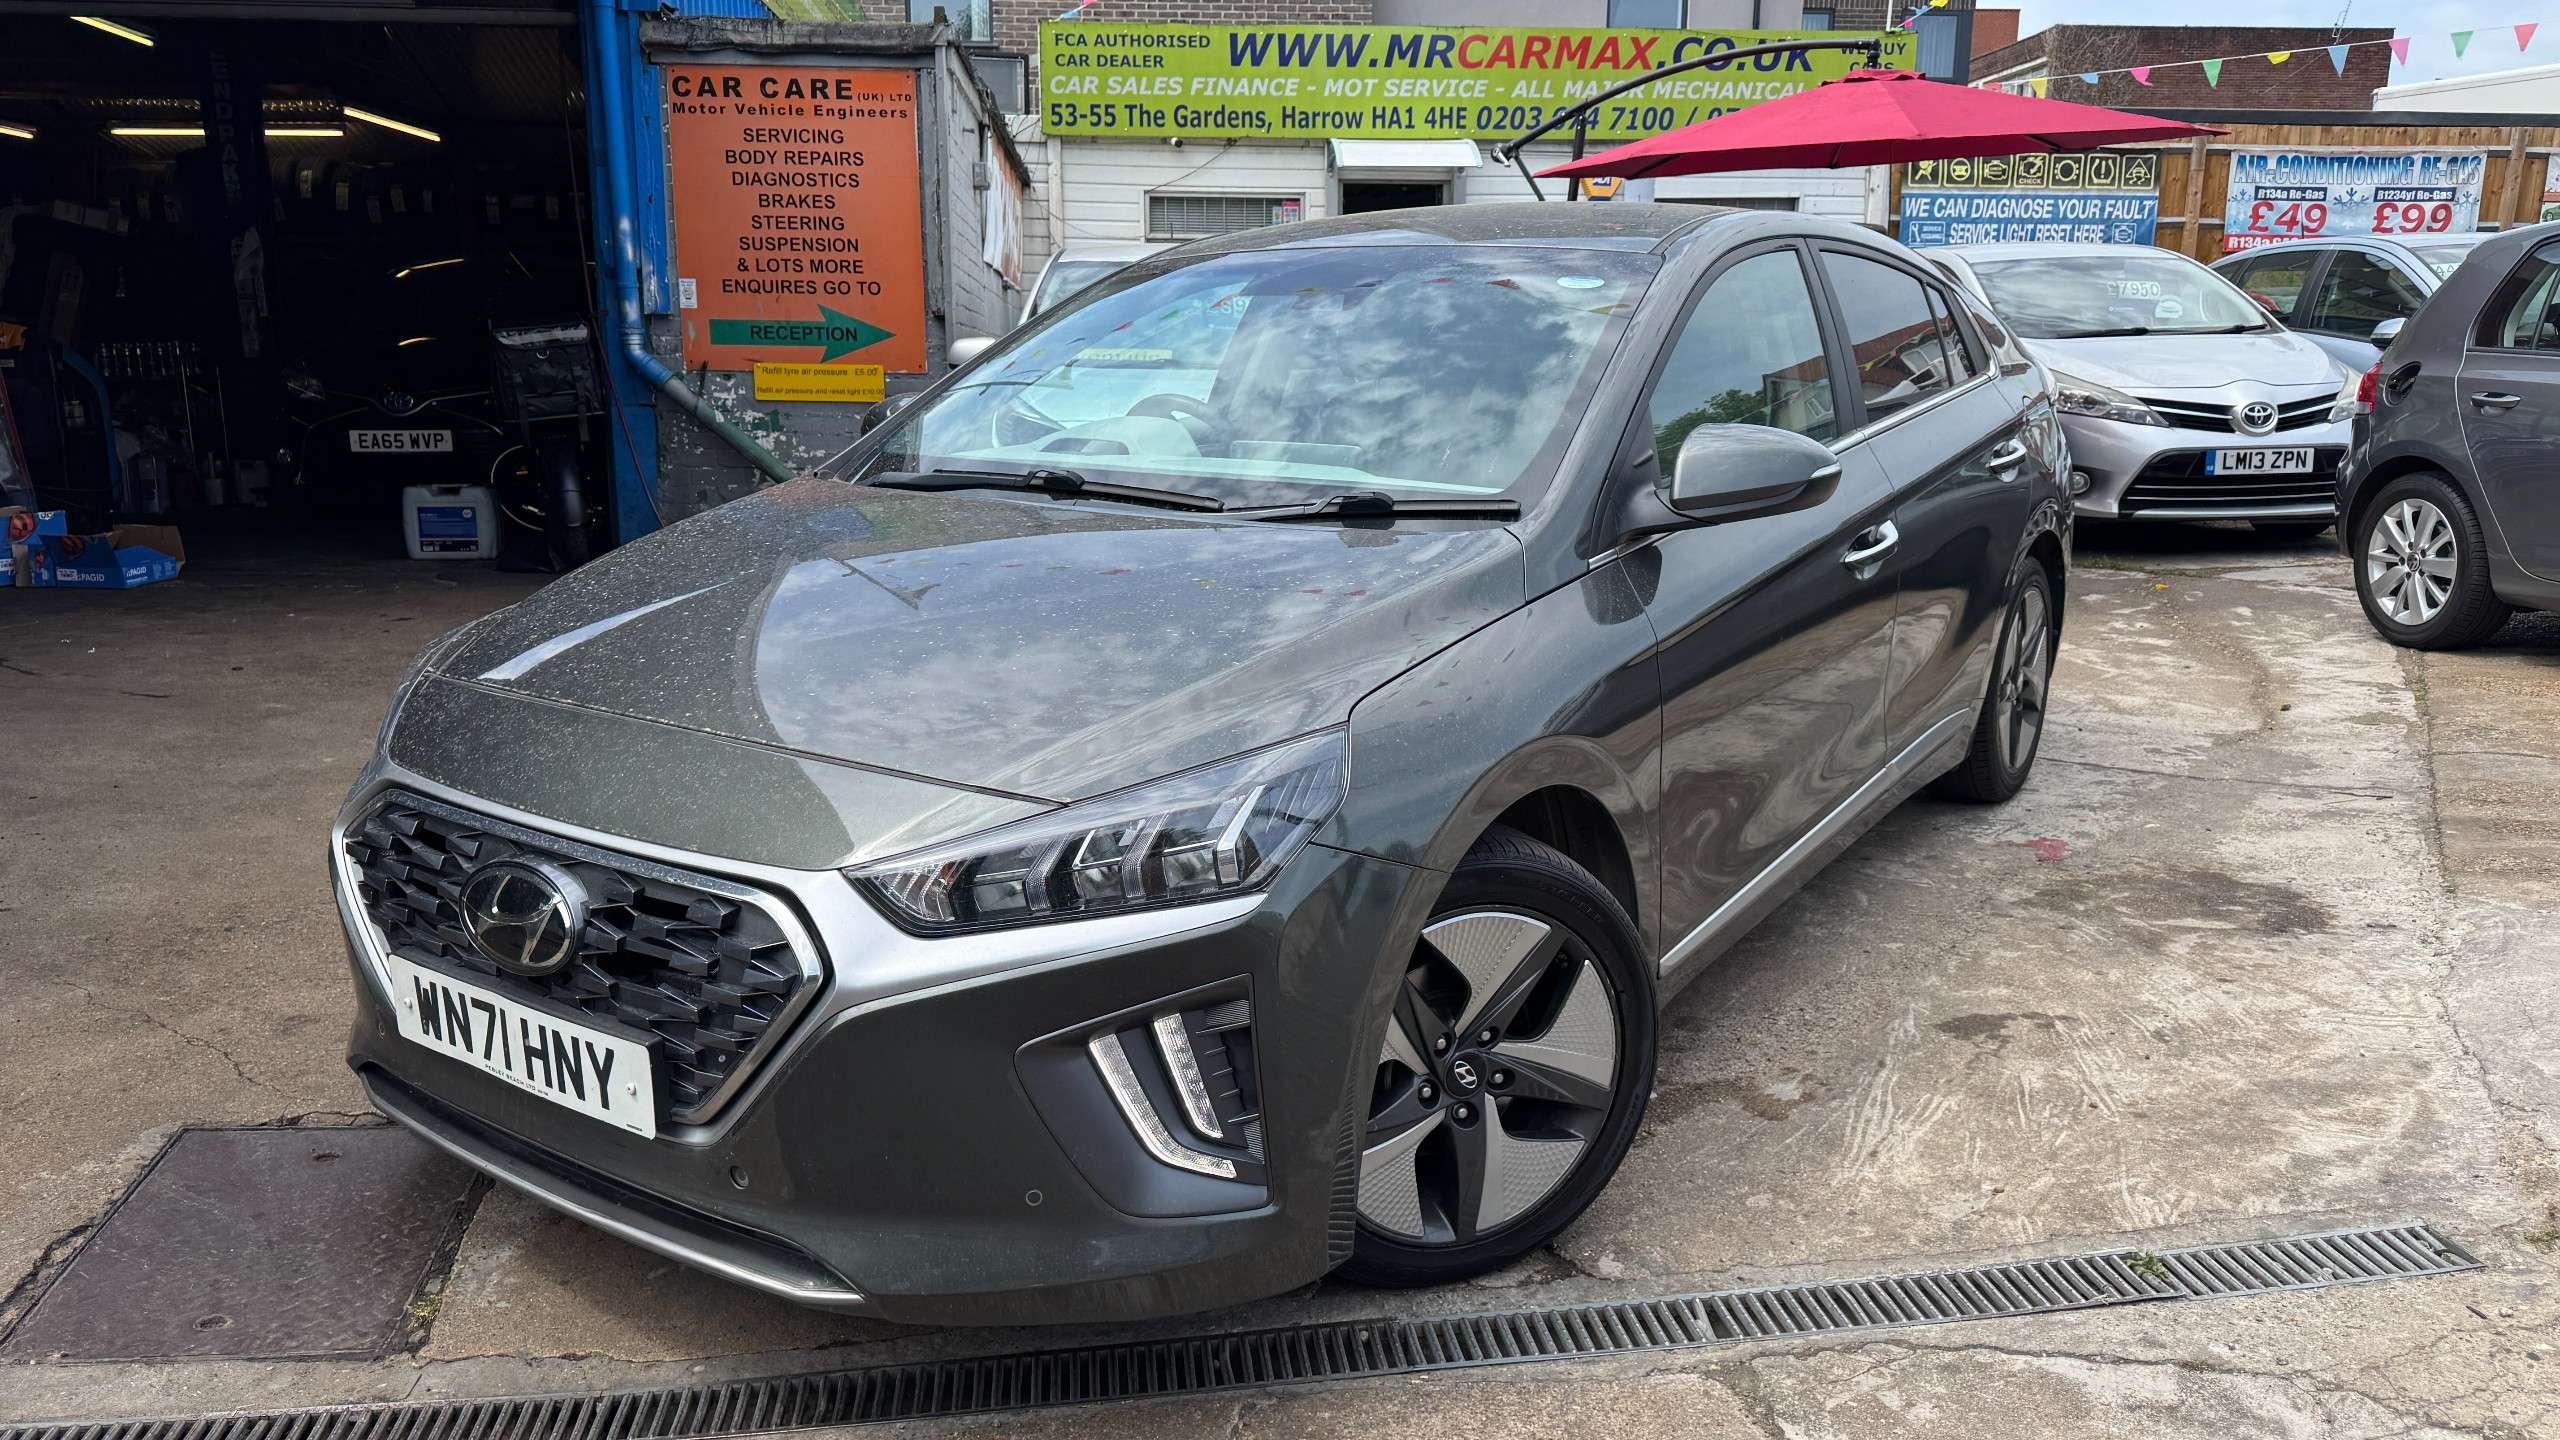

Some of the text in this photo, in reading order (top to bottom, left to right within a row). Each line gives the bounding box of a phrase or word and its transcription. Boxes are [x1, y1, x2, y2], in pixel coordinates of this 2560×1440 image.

[1054, 33, 1210, 48] FCA AUTHORISED
[1876, 43, 1907, 55] UY
[1055, 54, 1164, 68] CAR DEALER
[1850, 62, 1895, 71] CS
[672, 75, 912, 104] CAR CARE (UK) LTD
[1050, 76, 1099, 94] CAR
[1106, 76, 1183, 96] SALES
[1190, 77, 1300, 97] FINANCE
[1324, 78, 1378, 97] MOT
[1384, 79, 1488, 98] SERVICE
[1510, 79, 1555, 98] ALL
[672, 103, 908, 120] Motor Vehicle Engineers
[1050, 104, 1116, 128] 53-55
[1124, 104, 1166, 128] The
[1174, 104, 1272, 133] Gardens,
[1282, 106, 1364, 129] Harrow
[1372, 106, 1415, 129] HA1
[1424, 106, 1468, 129] 4HE
[1476, 106, 1543, 130] 0203
[1609, 107, 1676, 130] 7100
[743, 128, 845, 144] SERVICING
[725, 150, 864, 167] BODY REPAIRS
[2234, 154, 2482, 186] AIR-CONDITIONING RE-GAS
[732, 172, 860, 188] DIAGNOSTICS
[758, 194, 836, 209] BRAKES
[2258, 188, 2324, 200] R134a Re-Gas
[2377, 190, 2453, 200] R1234yf Re-Gas
[1905, 198, 2152, 220] WE CAN DIAGNOSE YOUR FAULT
[751, 215, 845, 231] STEERING
[2248, 201, 2328, 234] £49
[2372, 202, 2453, 234] £99
[1950, 222, 1997, 244] SERVICE
[2000, 224, 2032, 244] LIGHT
[2036, 224, 2071, 244] RESET
[2074, 224, 2104, 243] HERE
[739, 236, 860, 252] SUSPENSION
[2228, 236, 2270, 248] R134a
[737, 258, 864, 274] & LOTS MORE
[722, 279, 882, 296] ENQUIRES GO TO
[750, 326, 858, 342] RECEPTION
[814, 368, 848, 376] pressure
[358, 433, 444, 449] EA65 WVP
[2222, 450, 2308, 470] LM13 ZPN
[413, 974, 614, 1111] WN71 HNY
